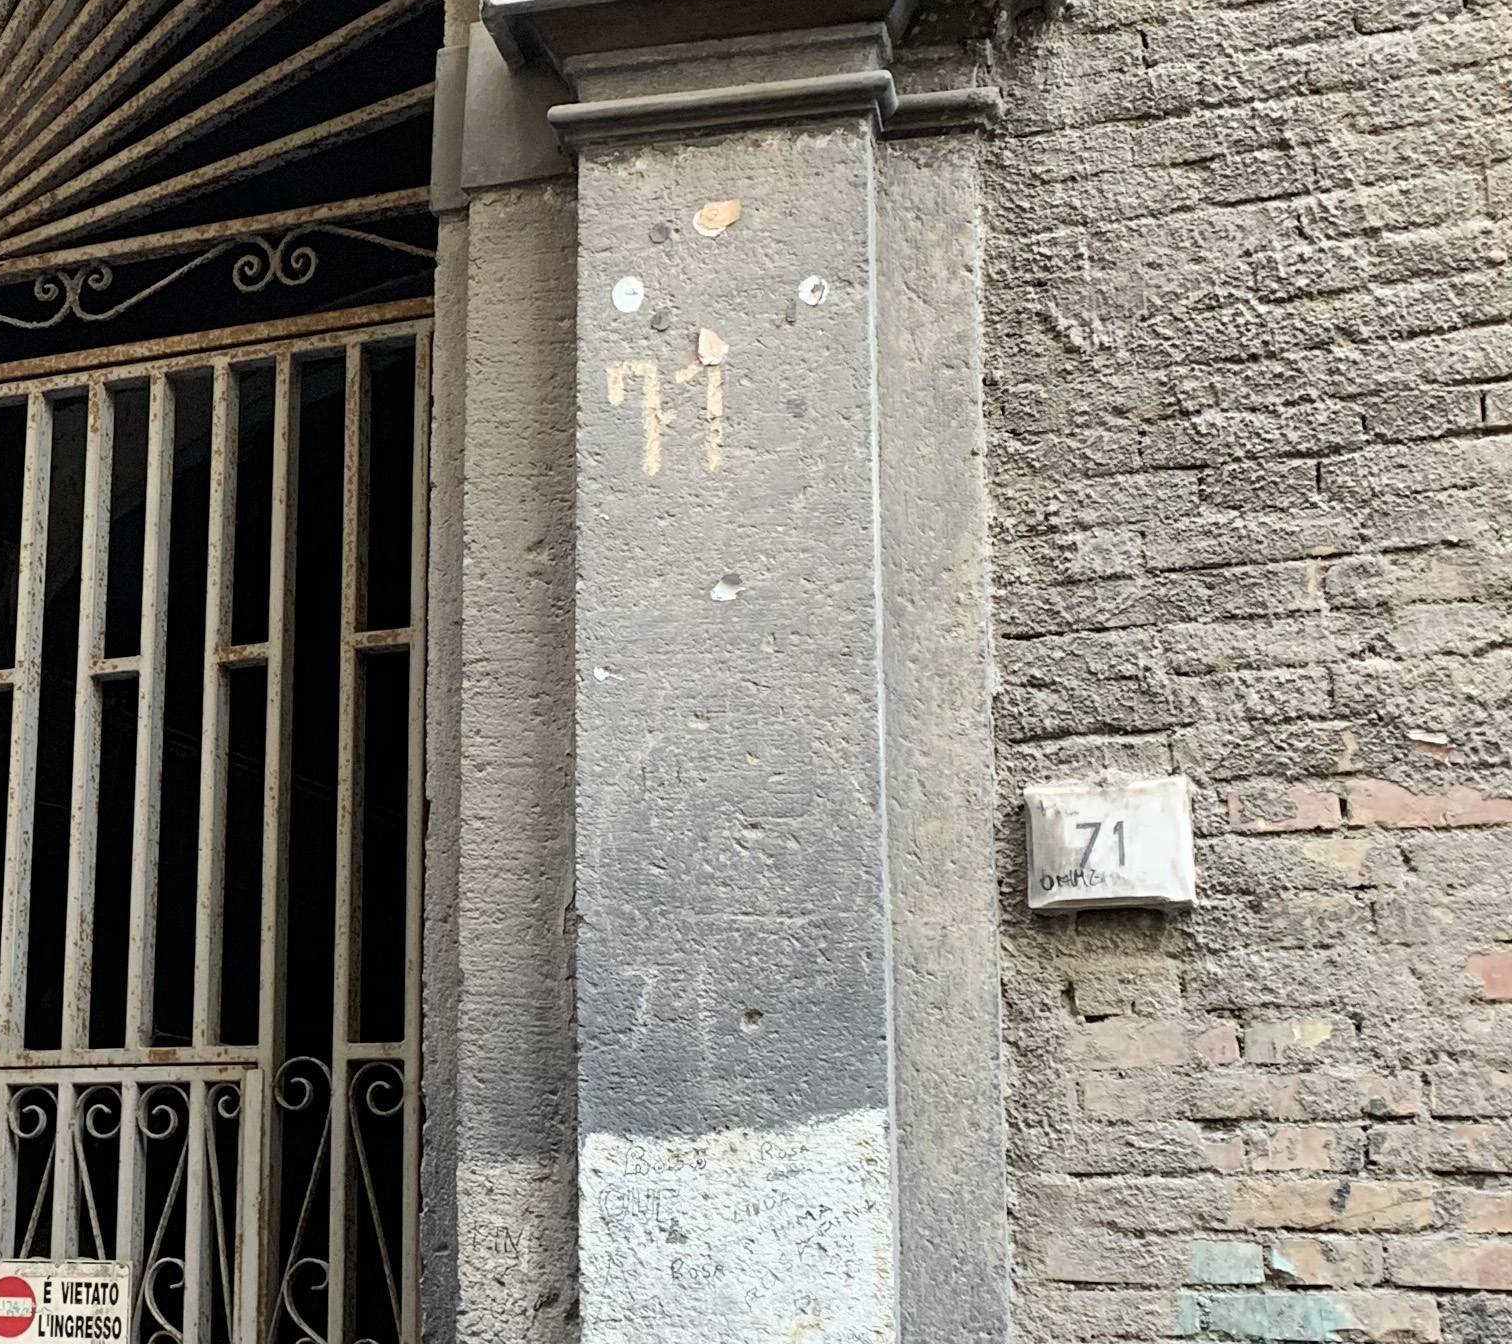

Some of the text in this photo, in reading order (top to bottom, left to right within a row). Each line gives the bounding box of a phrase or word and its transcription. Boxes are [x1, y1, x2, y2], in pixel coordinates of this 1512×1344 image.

[606, 358, 724, 476] 71
[1075, 820, 1125, 869] 71
[61, 1281, 120, 1306] VIETATO
[38, 1314, 122, 1340] L'INGRESSO
